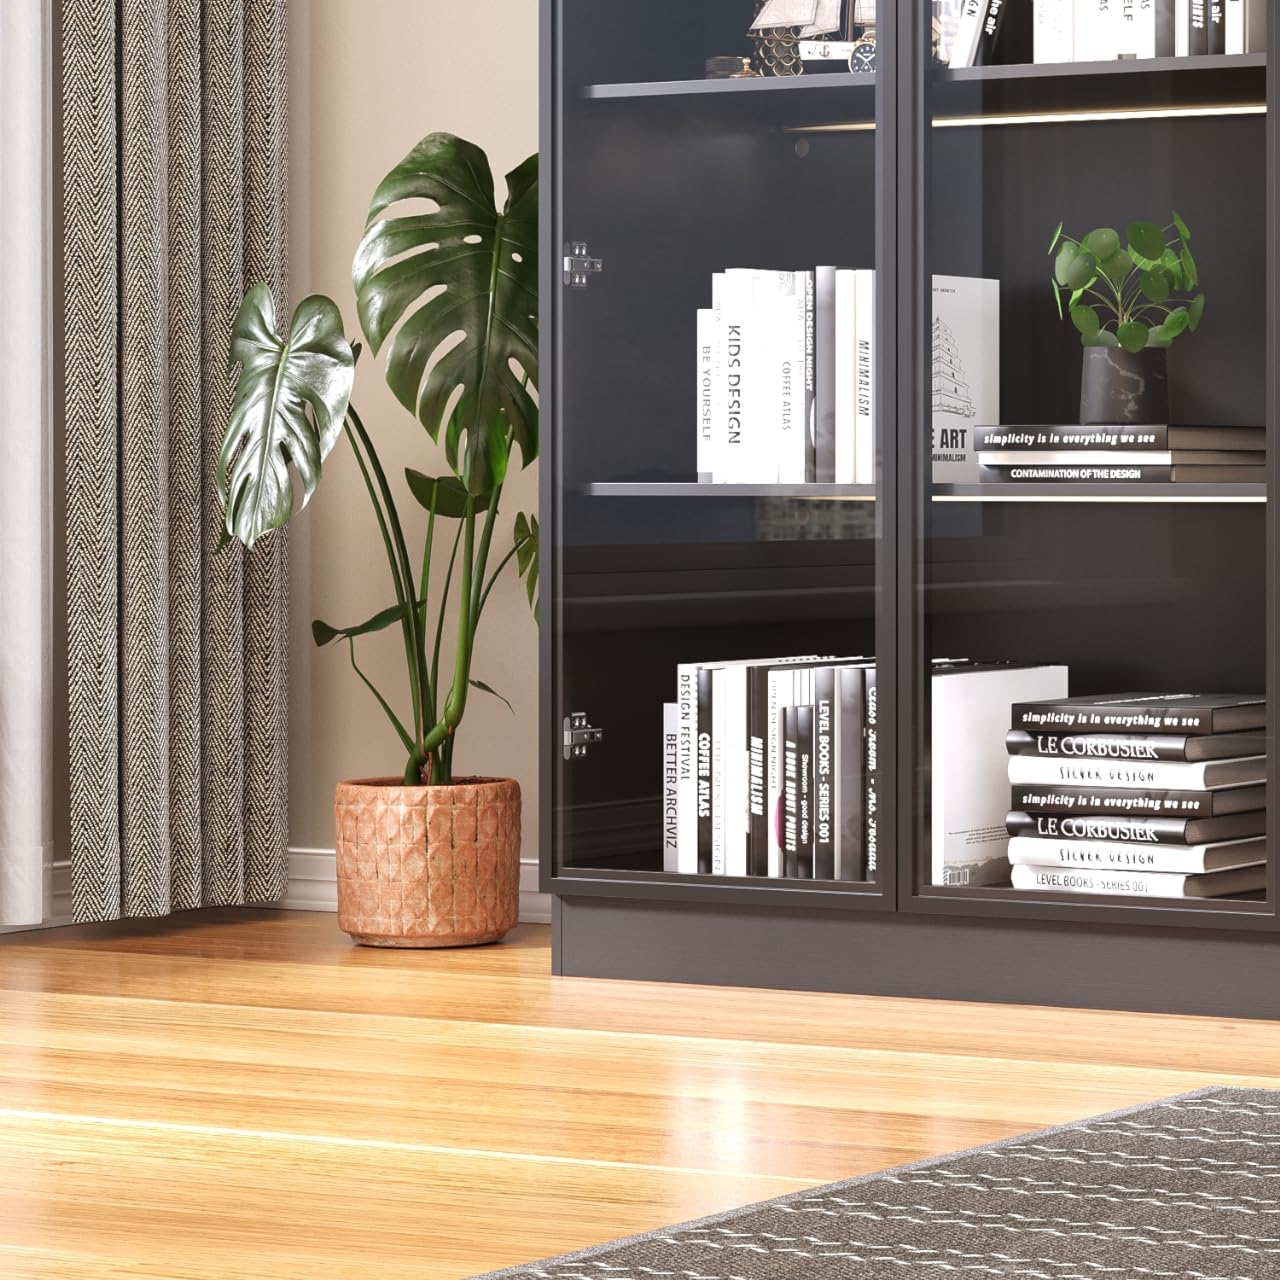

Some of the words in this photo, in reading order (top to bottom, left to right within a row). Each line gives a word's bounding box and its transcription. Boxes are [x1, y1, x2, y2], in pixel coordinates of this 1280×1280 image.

[985, 16, 996, 35] air
[1211, 5, 1222, 23] air
[728, 326, 740, 367] KIDS
[782, 362, 791, 396] COFFEE
[728, 374, 740, 443] DESIGN
[782, 401, 791, 430] ATLAS
[940, 429, 967, 449] ART
[984, 433, 1035, 445] simplicity
[1038, 433, 1047, 443] is
[1050, 433, 1059, 443] in
[1063, 434, 1117, 445] everything
[1120, 435, 1135, 443] we
[1137, 435, 1155, 443] see
[1011, 469, 1080, 478] CONTAMINATION
[1109, 470, 1141, 479] DESIGN
[681, 675, 690, 720] DESIGN
[819, 700, 829, 733] LEVEL
[1022, 712, 1075, 725] simplicity
[1078, 713, 1087, 724] is
[1090, 713, 1101, 724] in
[1104, 714, 1161, 727] everything
[1164, 717, 1178, 726] we
[1182, 717, 1200, 726] see
[666, 734, 677, 783] BETTER
[681, 727, 690, 780] FESTIVAL
[698, 732, 710, 776] COFFEE
[819, 736, 829, 775] BOOKS
[1037, 736, 1058, 754] LE
[1061, 737, 1158, 758] CORBUSIER
[1109, 768, 1154, 782] DESIGN
[698, 779, 710, 818] ATLAS
[819, 783, 829, 821] SERIES
[666, 787, 677, 849] ARCHVIZ
[1037, 818, 1058, 835] LE
[1061, 818, 1158, 841] CORBUSIER
[819, 823, 829, 843] 001
[1109, 851, 1154, 864] DESIGN
[1037, 873, 1062, 885] LEVEL
[1064, 875, 1094, 888] BOOKS
